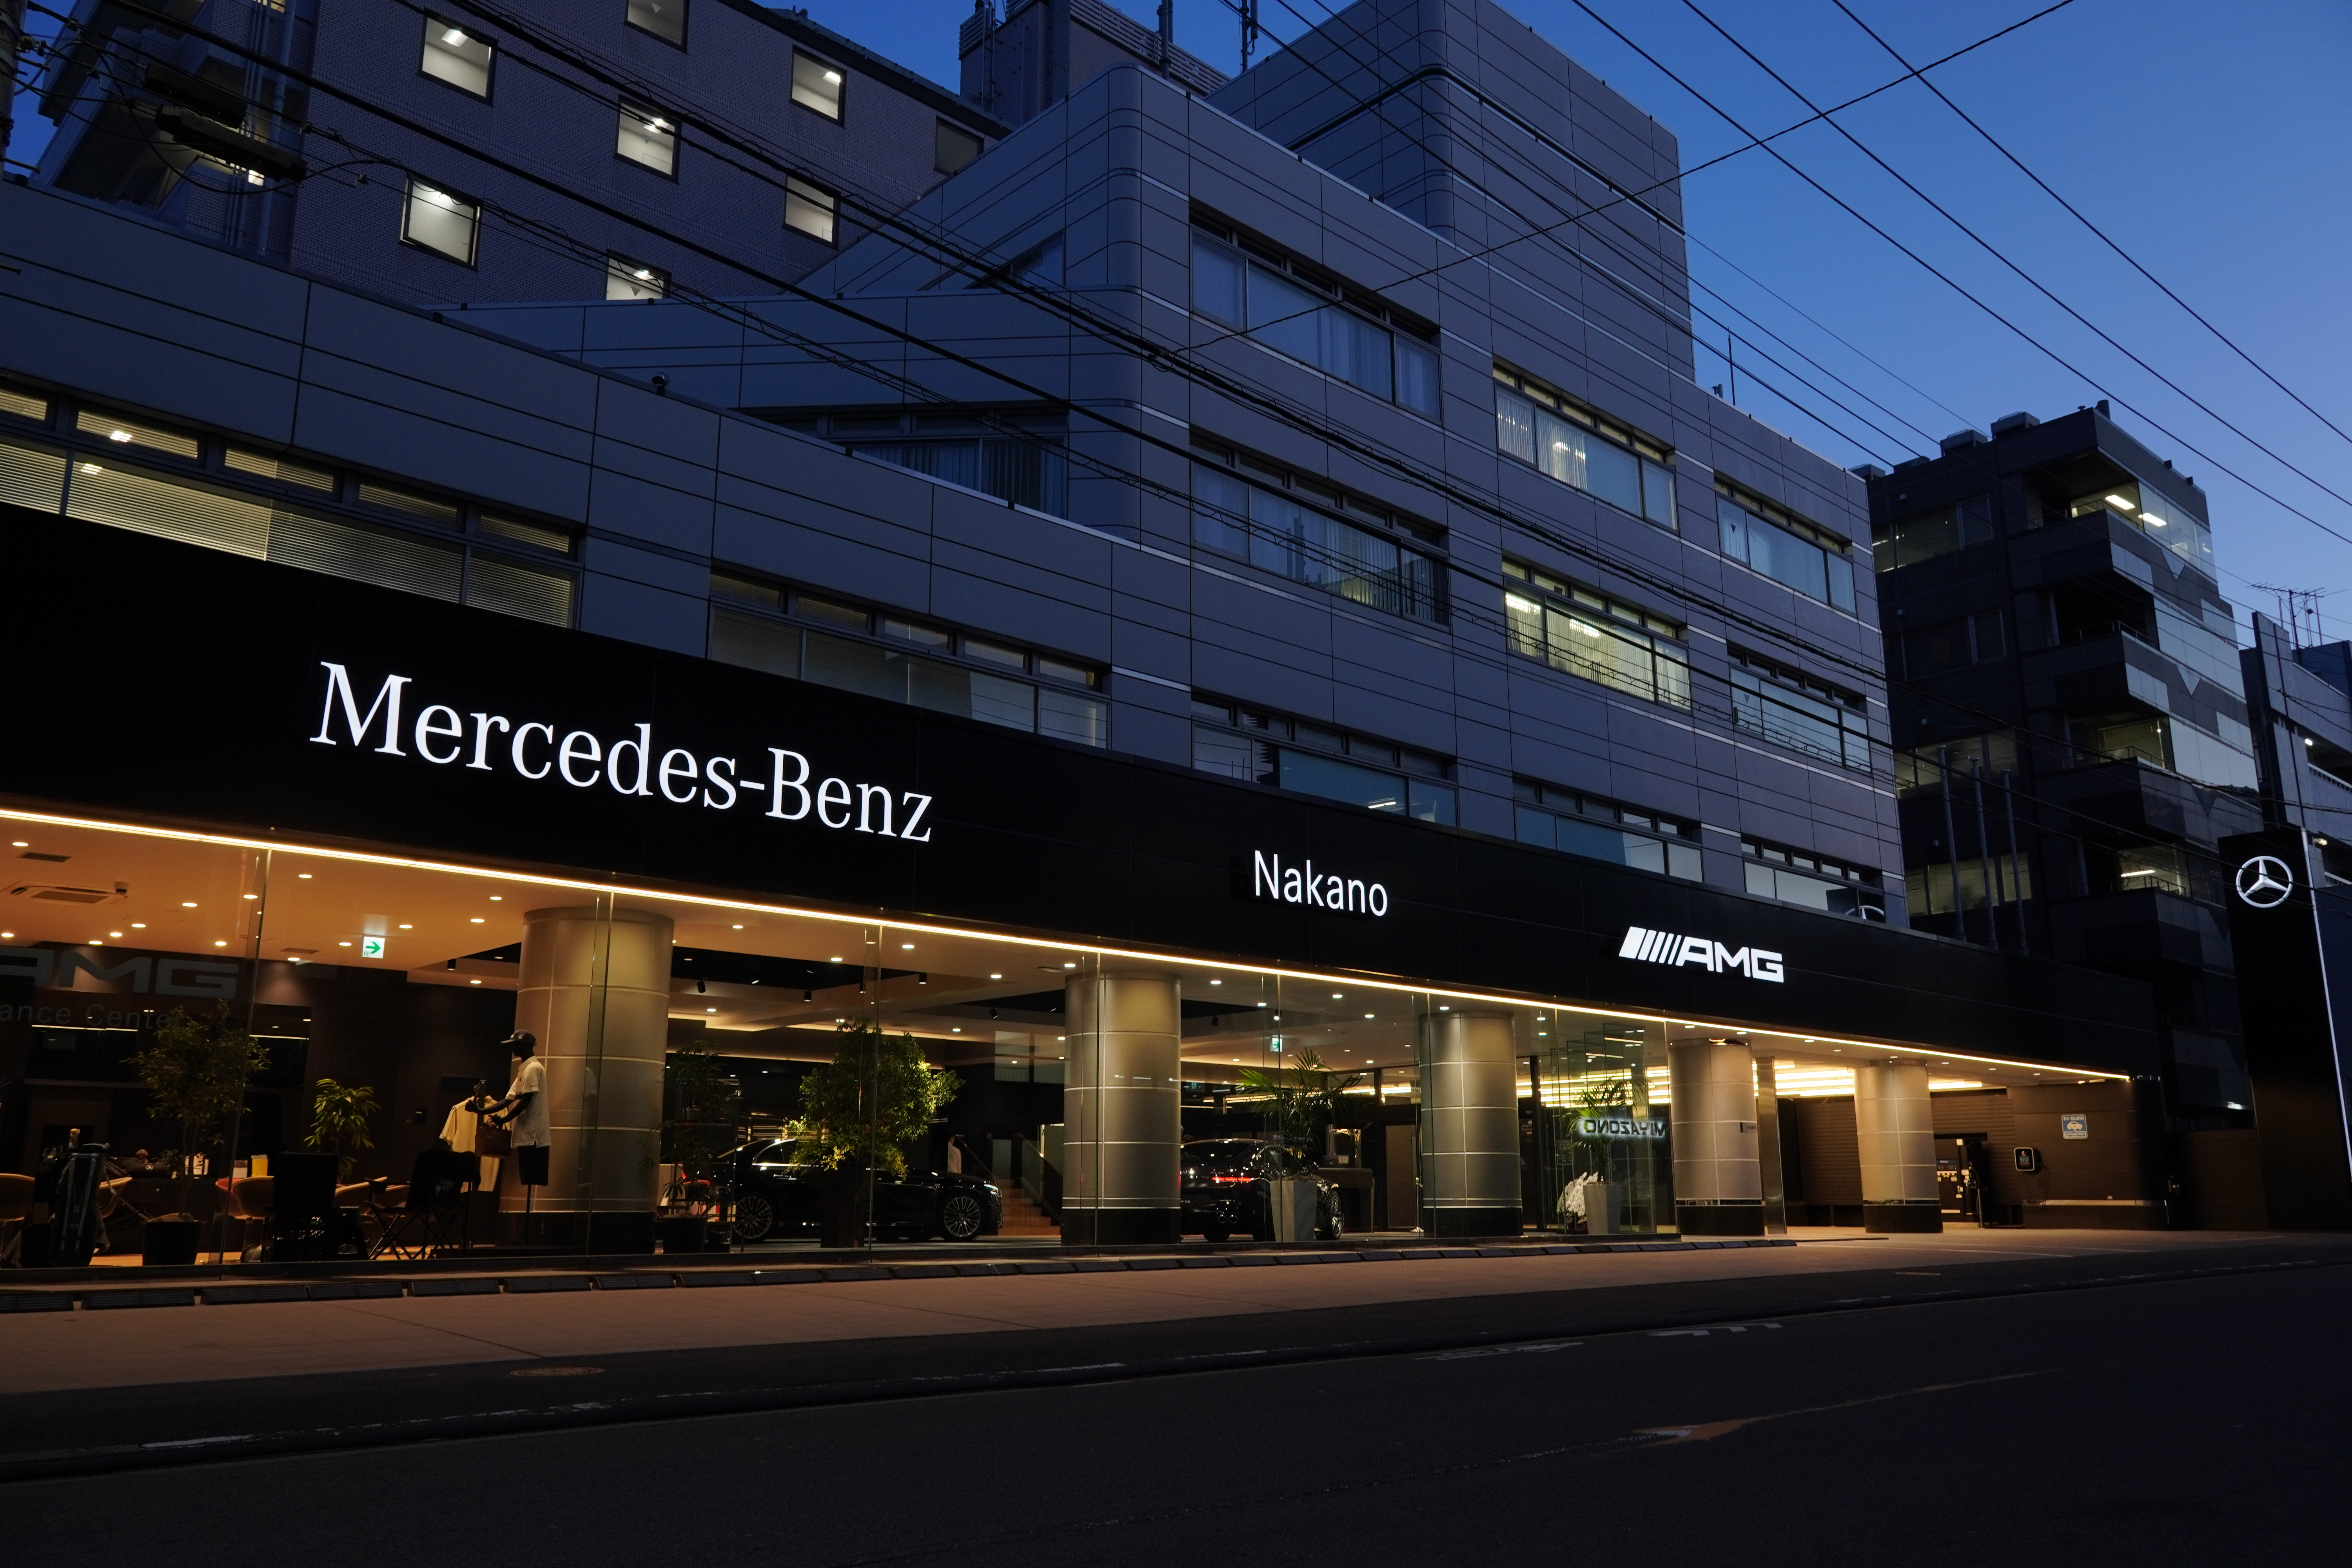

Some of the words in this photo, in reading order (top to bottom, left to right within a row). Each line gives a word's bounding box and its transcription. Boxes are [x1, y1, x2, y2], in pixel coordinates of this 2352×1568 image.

[309, 661, 932, 842] Mercedes-Benz
[1255, 850, 1388, 916] Nakano
[1675, 936, 1784, 983] AMG
